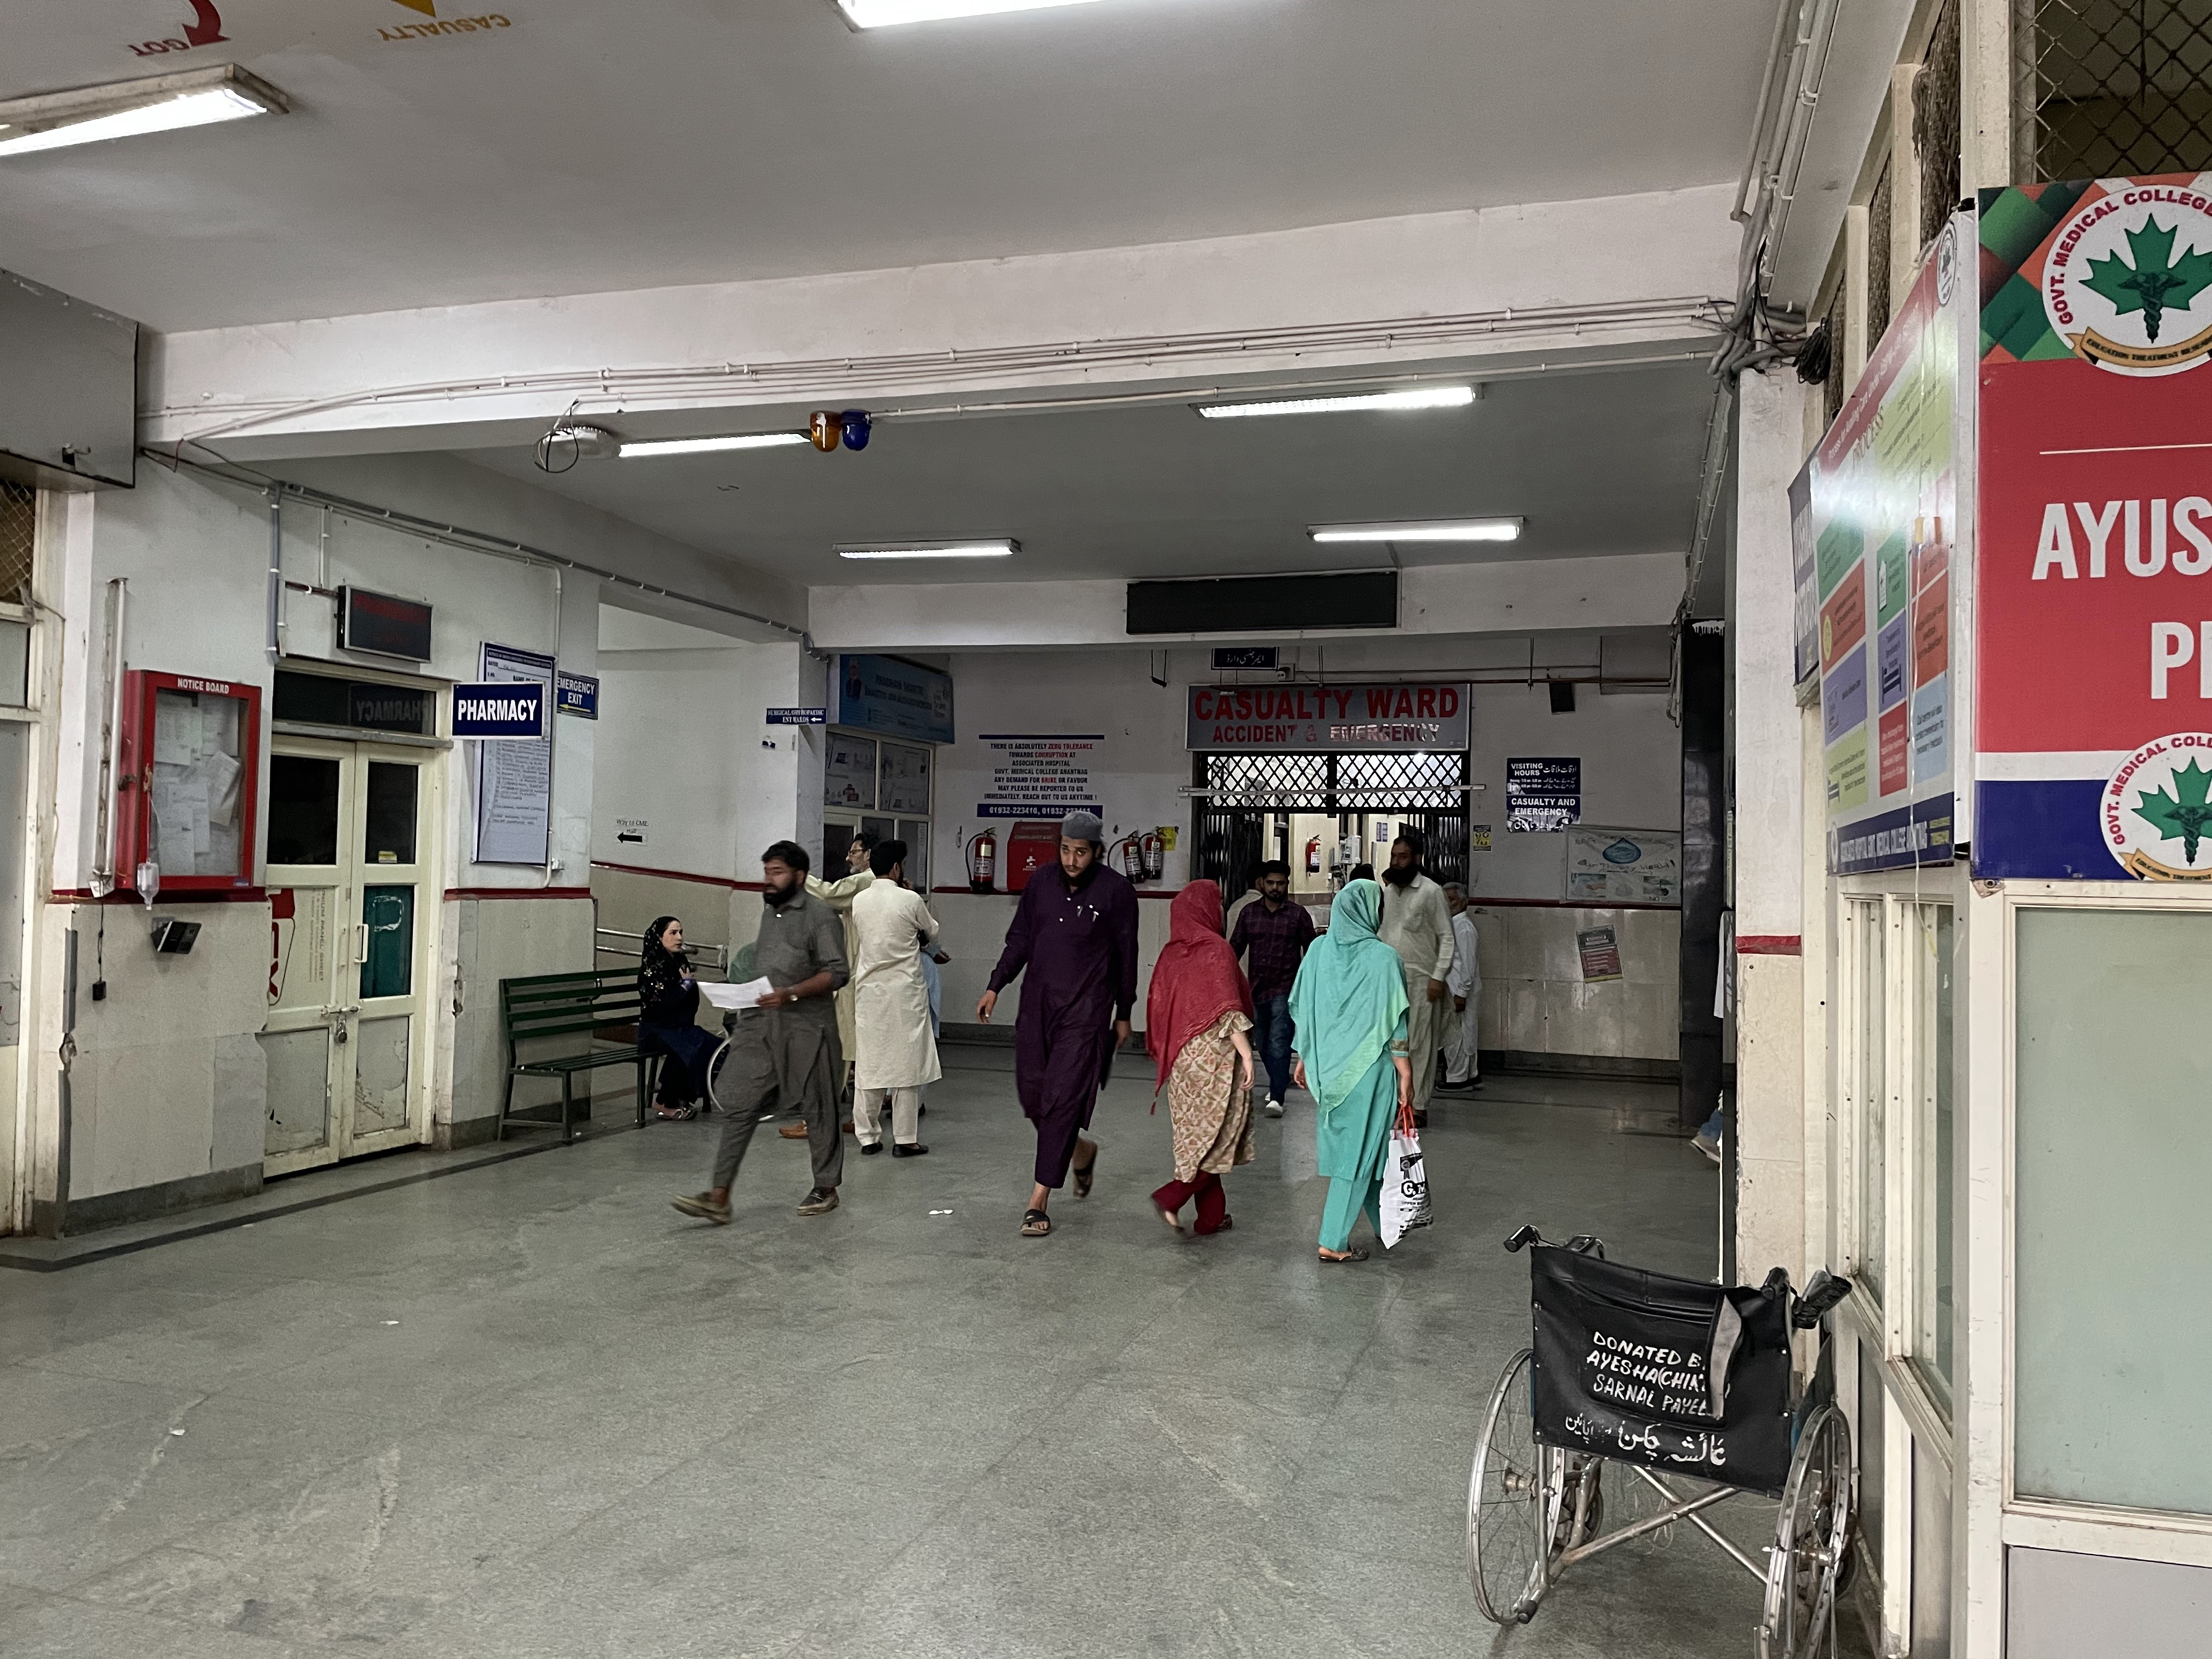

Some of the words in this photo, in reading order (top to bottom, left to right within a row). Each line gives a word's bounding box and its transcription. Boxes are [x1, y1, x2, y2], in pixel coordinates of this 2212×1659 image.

[376, 14, 511, 41] CASUALTY
[2053, 201, 2120, 267] MEDICAL
[2050, 272, 2074, 325] GOVT.
[177, 677, 204, 690] NOTICE
[206, 682, 229, 693] BOARD
[557, 678, 595, 695] EMERGENCY
[568, 692, 583, 705] EXIT
[458, 699, 538, 721] PHARMACY
[1195, 689, 1353, 720] CASUALTY
[1367, 687, 1459, 719] WARD
[1213, 724, 1297, 743] ACCIDENT
[1330, 722, 1440, 742] EMERGENCY
[2110, 743, 2167, 796] MEDICAL
[1515, 808, 1568, 816] EMERGENCY
[2107, 801, 2125, 845] GOVT.
[1593, 1331, 1681, 1365] DONATED
[1593, 1374, 1654, 1408] SARNAL
